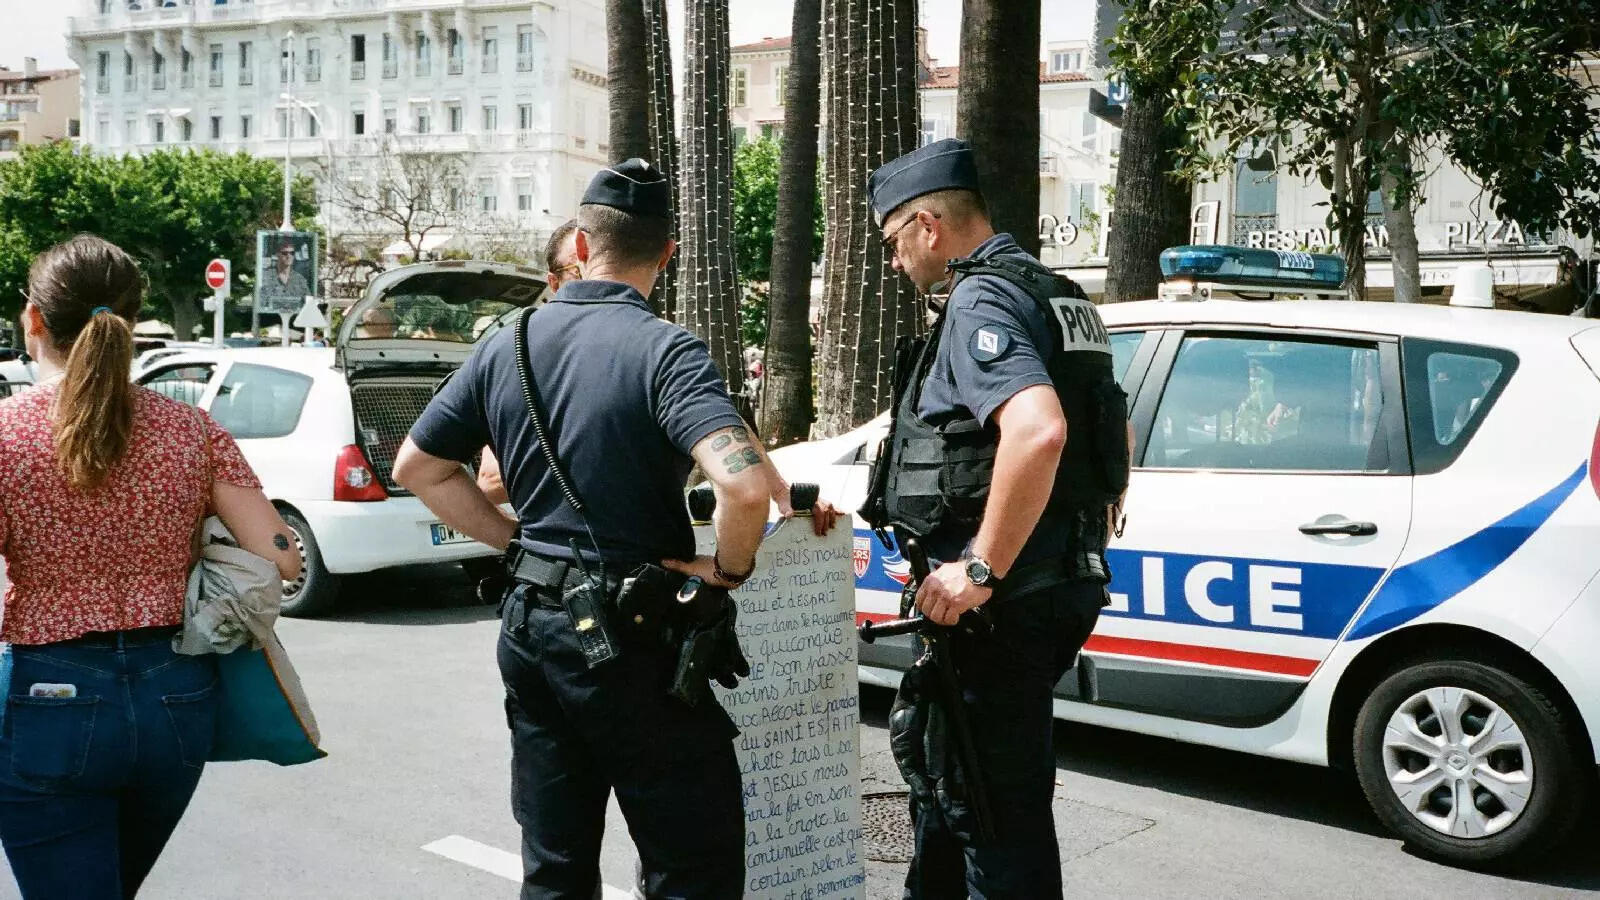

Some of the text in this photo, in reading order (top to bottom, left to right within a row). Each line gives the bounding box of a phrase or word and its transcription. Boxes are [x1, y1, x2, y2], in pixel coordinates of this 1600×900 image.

[1248, 225, 1389, 250] RESTAUAN
[1445, 219, 1525, 247] PIZZA
[764, 721, 804, 749] SAINT
